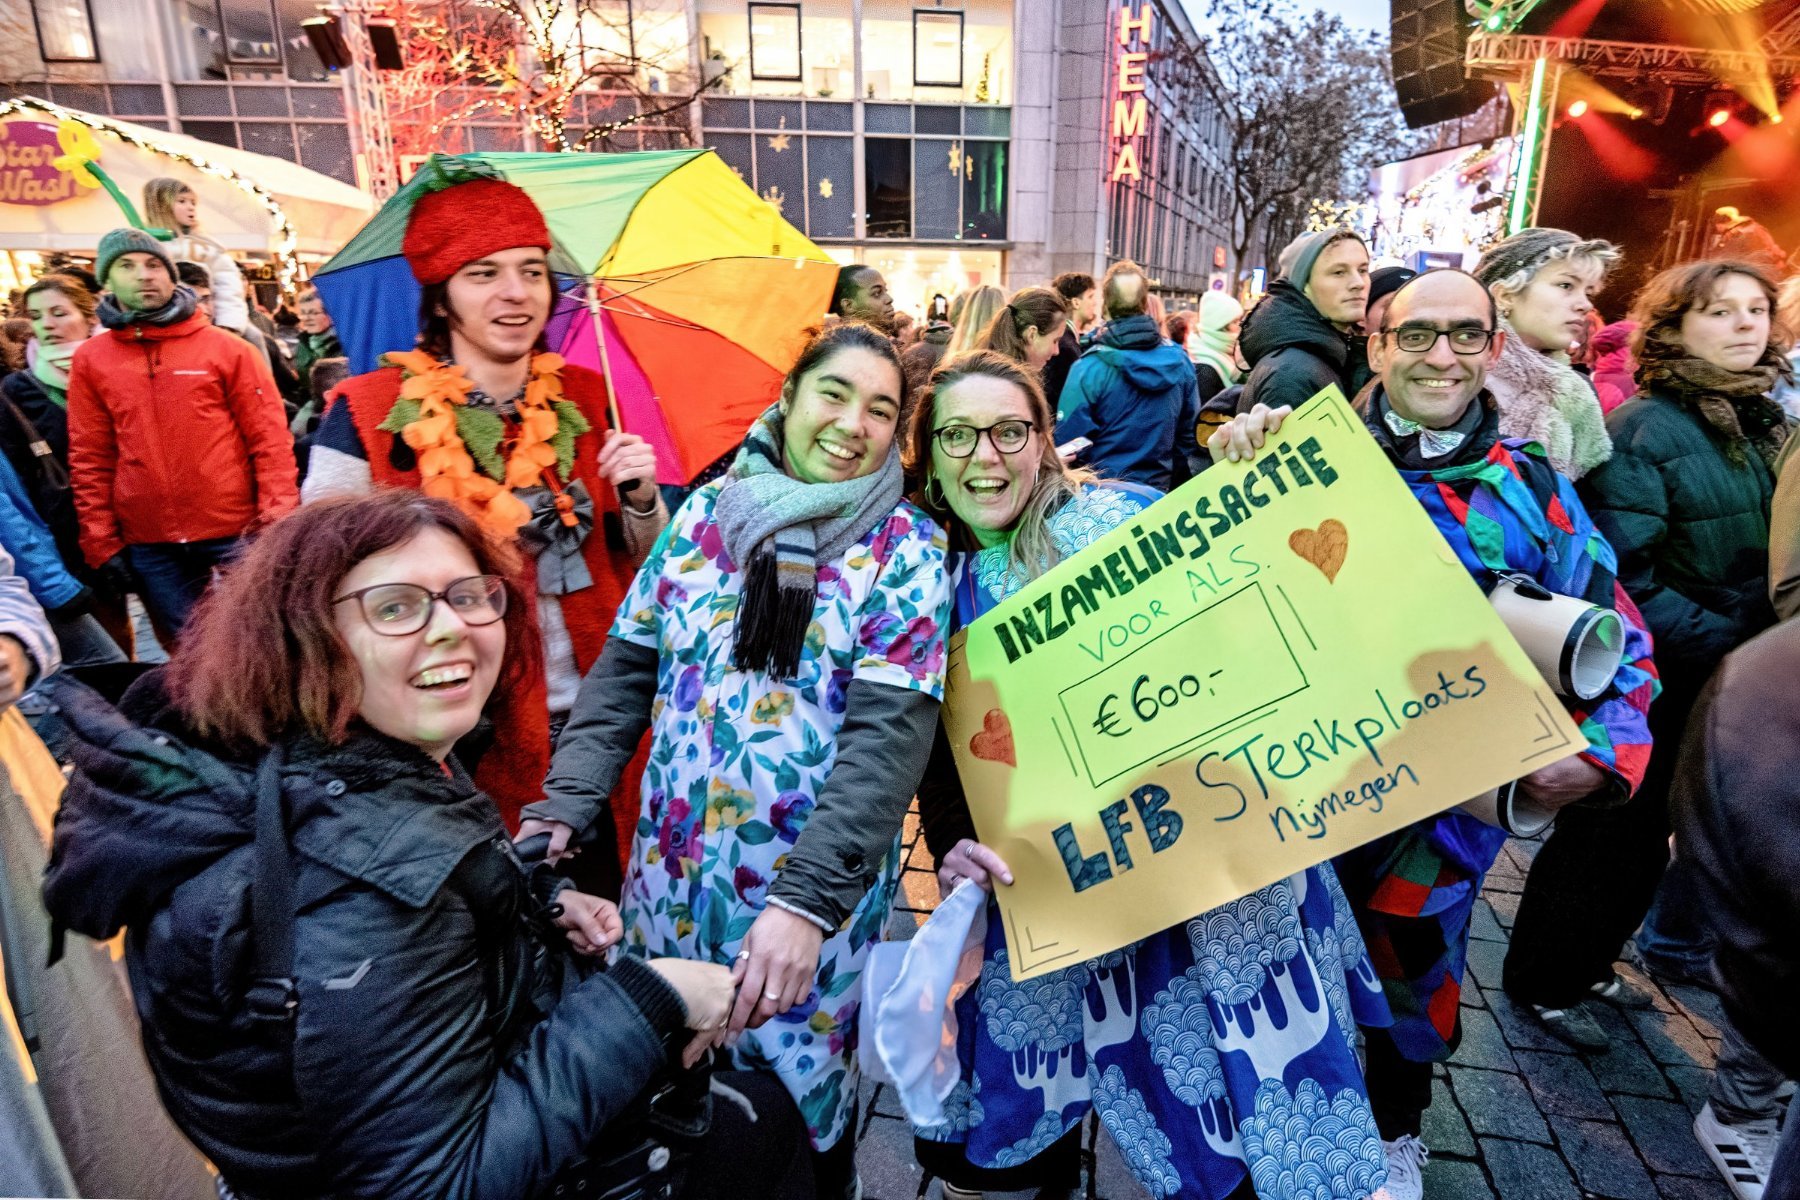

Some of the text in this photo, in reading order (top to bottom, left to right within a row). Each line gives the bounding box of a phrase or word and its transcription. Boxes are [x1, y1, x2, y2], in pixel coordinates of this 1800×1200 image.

[1112, 4, 1150, 182] HEMA
[1078, 600, 1169, 662] VOOR
[1052, 783, 1184, 893] LFB
